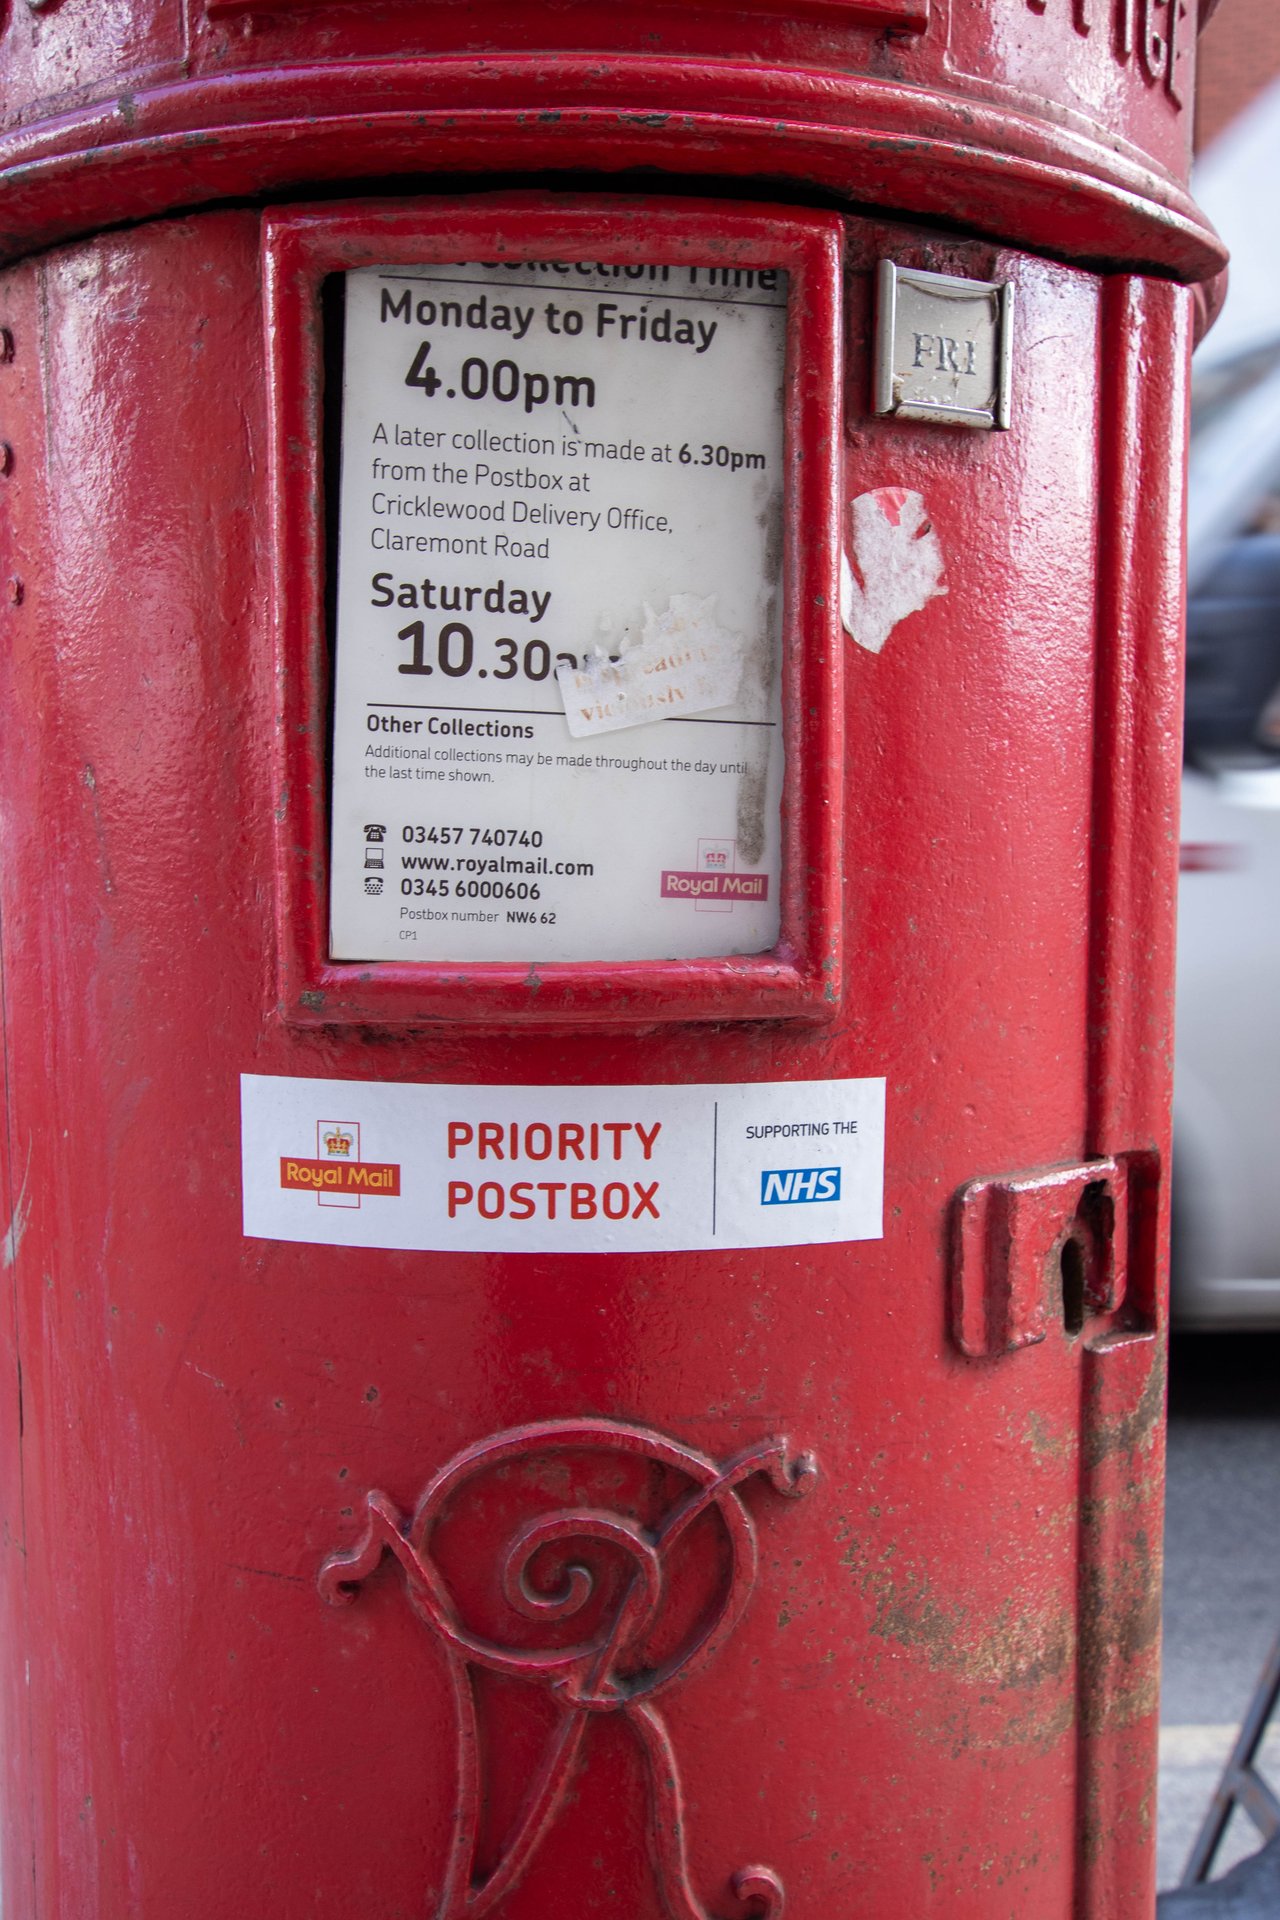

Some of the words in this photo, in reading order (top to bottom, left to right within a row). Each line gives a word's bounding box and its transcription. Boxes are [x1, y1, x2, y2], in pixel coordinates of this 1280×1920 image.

[380, 288, 535, 340] Monday
[544, 303, 583, 336] to
[597, 303, 718, 354] Friday
[912, 332, 977, 375] FRI
[404, 341, 595, 414] 4.00pm
[372, 423, 388, 445] A
[395, 424, 447, 448] later
[452, 429, 555, 455] collection
[562, 438, 578, 457] is
[584, 439, 645, 461] made
[651, 444, 672, 463] at
[678, 443, 766, 472] 6.30pm
[372, 458, 425, 482] from
[432, 462, 468, 484] the
[475, 464, 563, 490] Postbox
[568, 473, 590, 492] at
[372, 493, 505, 521] Cricklewood
[513, 501, 601, 532] Delivery
[607, 507, 672, 534] Office,
[371, 528, 488, 555] Claremont
[495, 532, 549, 559] Road
[371, 572, 552, 623] Saturday
[397, 619, 621, 682] 10.30a
[367, 714, 423, 734] Other
[428, 717, 534, 739] Collections
[364, 765, 386, 778] the
[389, 765, 413, 779] last
[415, 767, 445, 781] time
[448, 768, 494, 782] shown.
[365, 744, 431, 760] Additional
[434, 748, 503, 763] collections
[506, 754, 534, 767] may
[537, 752, 553, 765] be
[556, 754, 592, 767] made
[595, 755, 668, 772] throughout
[671, 759, 692, 771] the
[694, 760, 717, 775] day
[719, 759, 747, 775] until
[402, 825, 464, 845] 03457
[469, 828, 543, 848] 740740
[401, 856, 594, 876] www.royalmail.com
[401, 878, 449, 897] 0345
[455, 880, 541, 900] 6000606
[667, 874, 718, 896] Royal
[723, 876, 763, 894] Mail
[400, 907, 448, 920] Postbox
[451, 910, 500, 922] number
[506, 911, 537, 924] NW6
[540, 912, 556, 924] 62
[399, 930, 417, 940] CP1
[447, 1121, 662, 1161] PRIORITY
[746, 1123, 831, 1140] SUPPORTING
[833, 1120, 858, 1135] THE
[286, 1162, 343, 1189] Royal
[348, 1166, 393, 1189] Mail
[765, 1170, 838, 1203] NHS
[447, 1180, 661, 1221] POSTBOX
